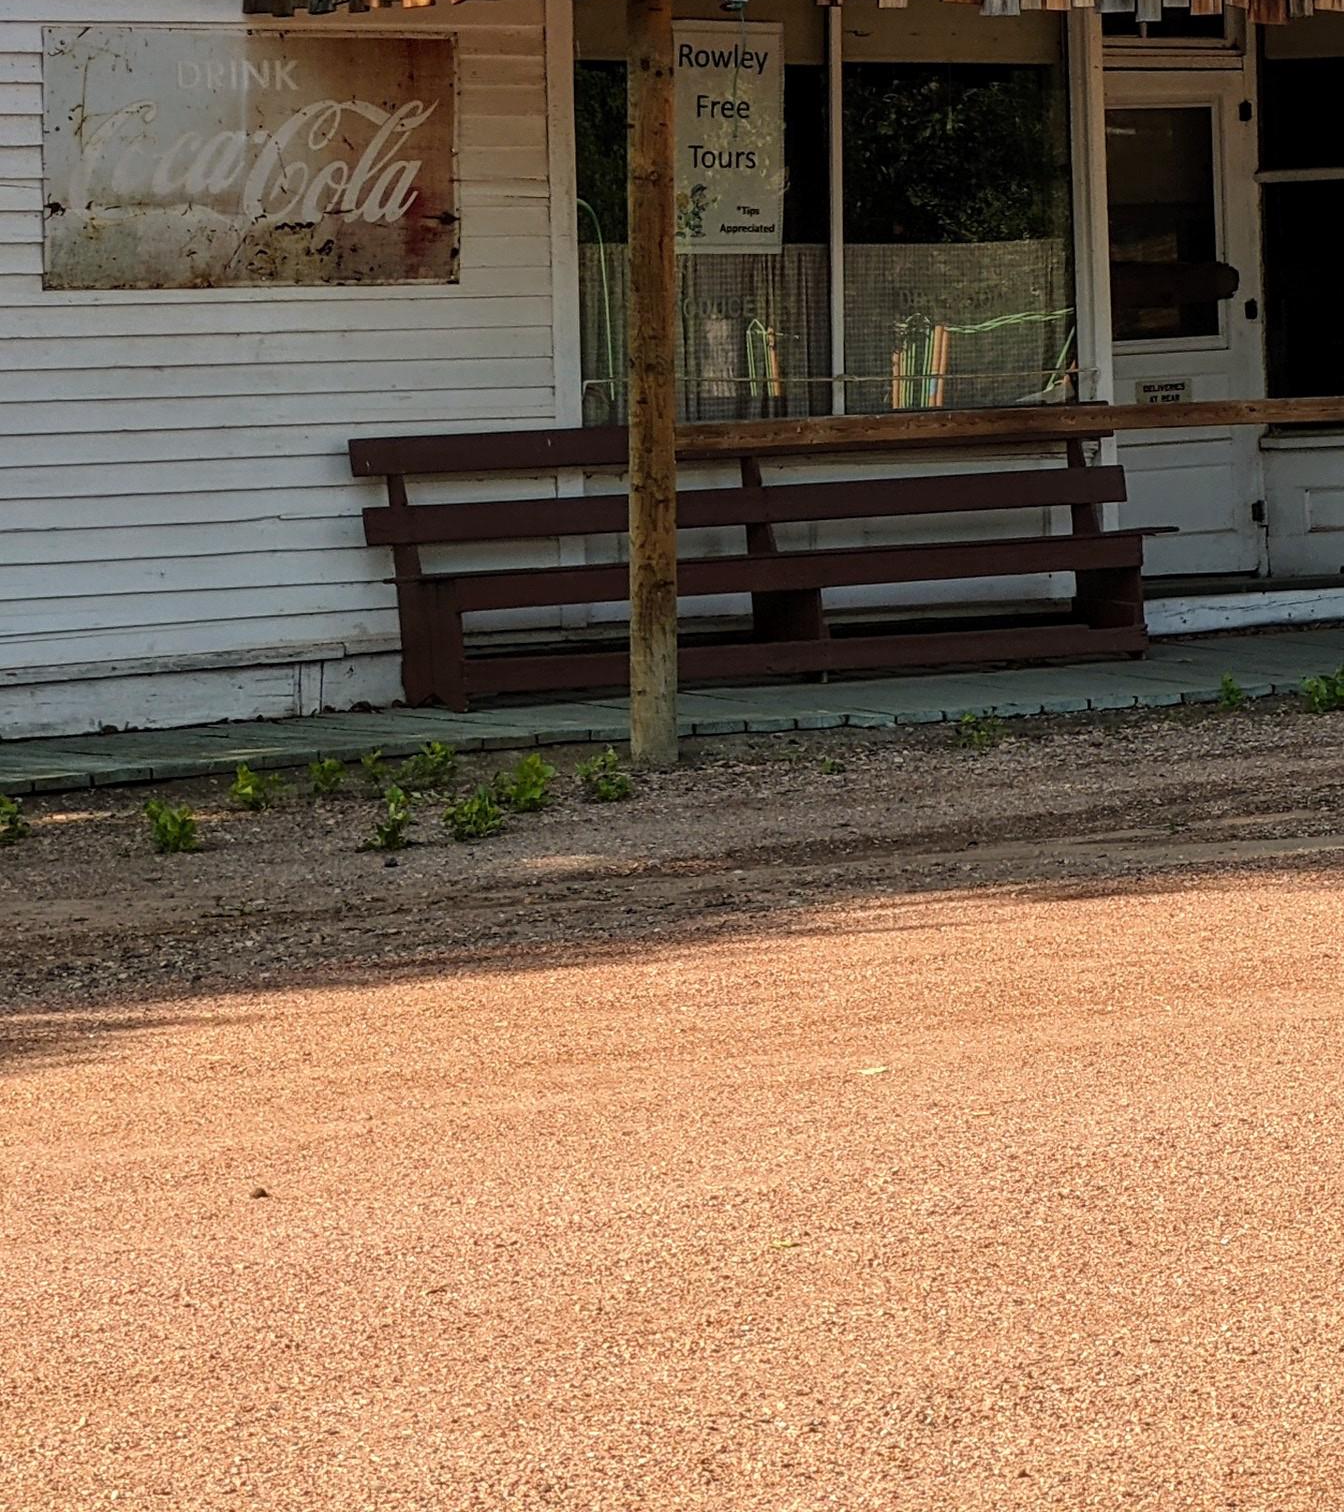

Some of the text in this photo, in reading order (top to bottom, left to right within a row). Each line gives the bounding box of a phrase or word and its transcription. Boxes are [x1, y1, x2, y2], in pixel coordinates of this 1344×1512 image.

[678, 42, 769, 75] Rowley
[176, 59, 301, 91] DRINK
[695, 94, 751, 119] Free
[687, 144, 757, 169] Tours
[719, 223, 776, 235] Appreciated
[682, 296, 758, 318] ODUCE
[1149, 395, 1158, 403] AT
